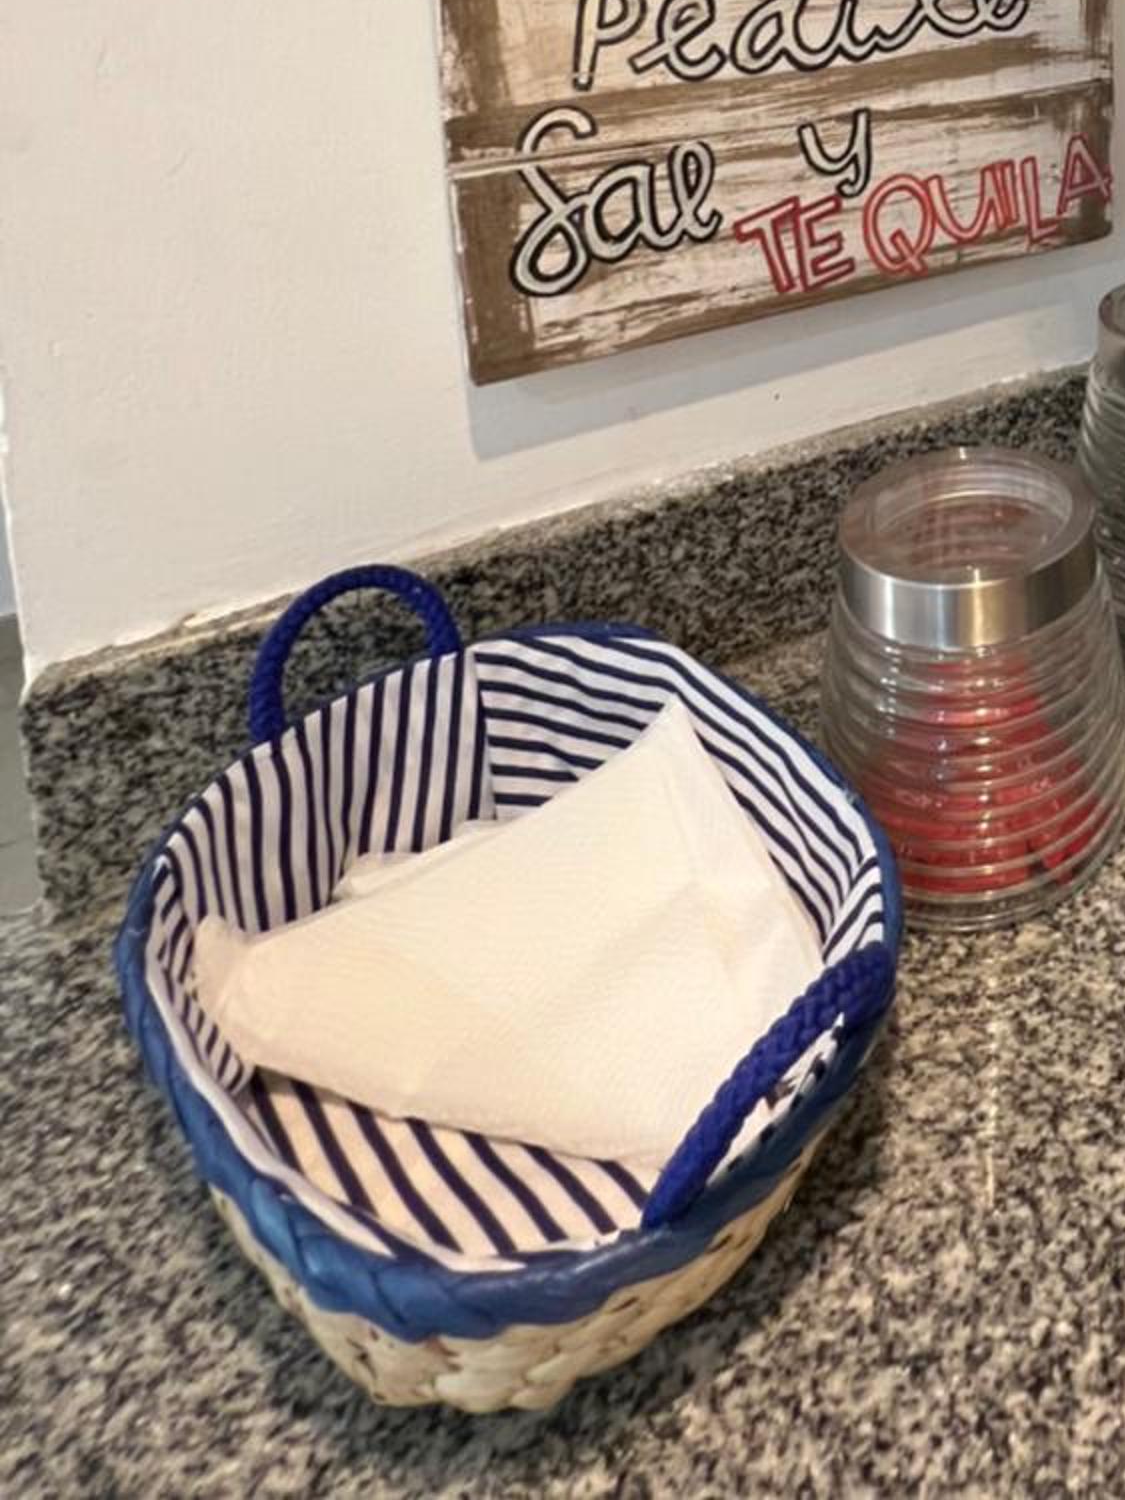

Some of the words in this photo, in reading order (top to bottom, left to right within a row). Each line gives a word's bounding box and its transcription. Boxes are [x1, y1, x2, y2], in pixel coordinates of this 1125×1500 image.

[510, 105, 723, 298] Sal
[732, 132, 1112, 295] TEQUILA
[798, 107, 872, 197] y
